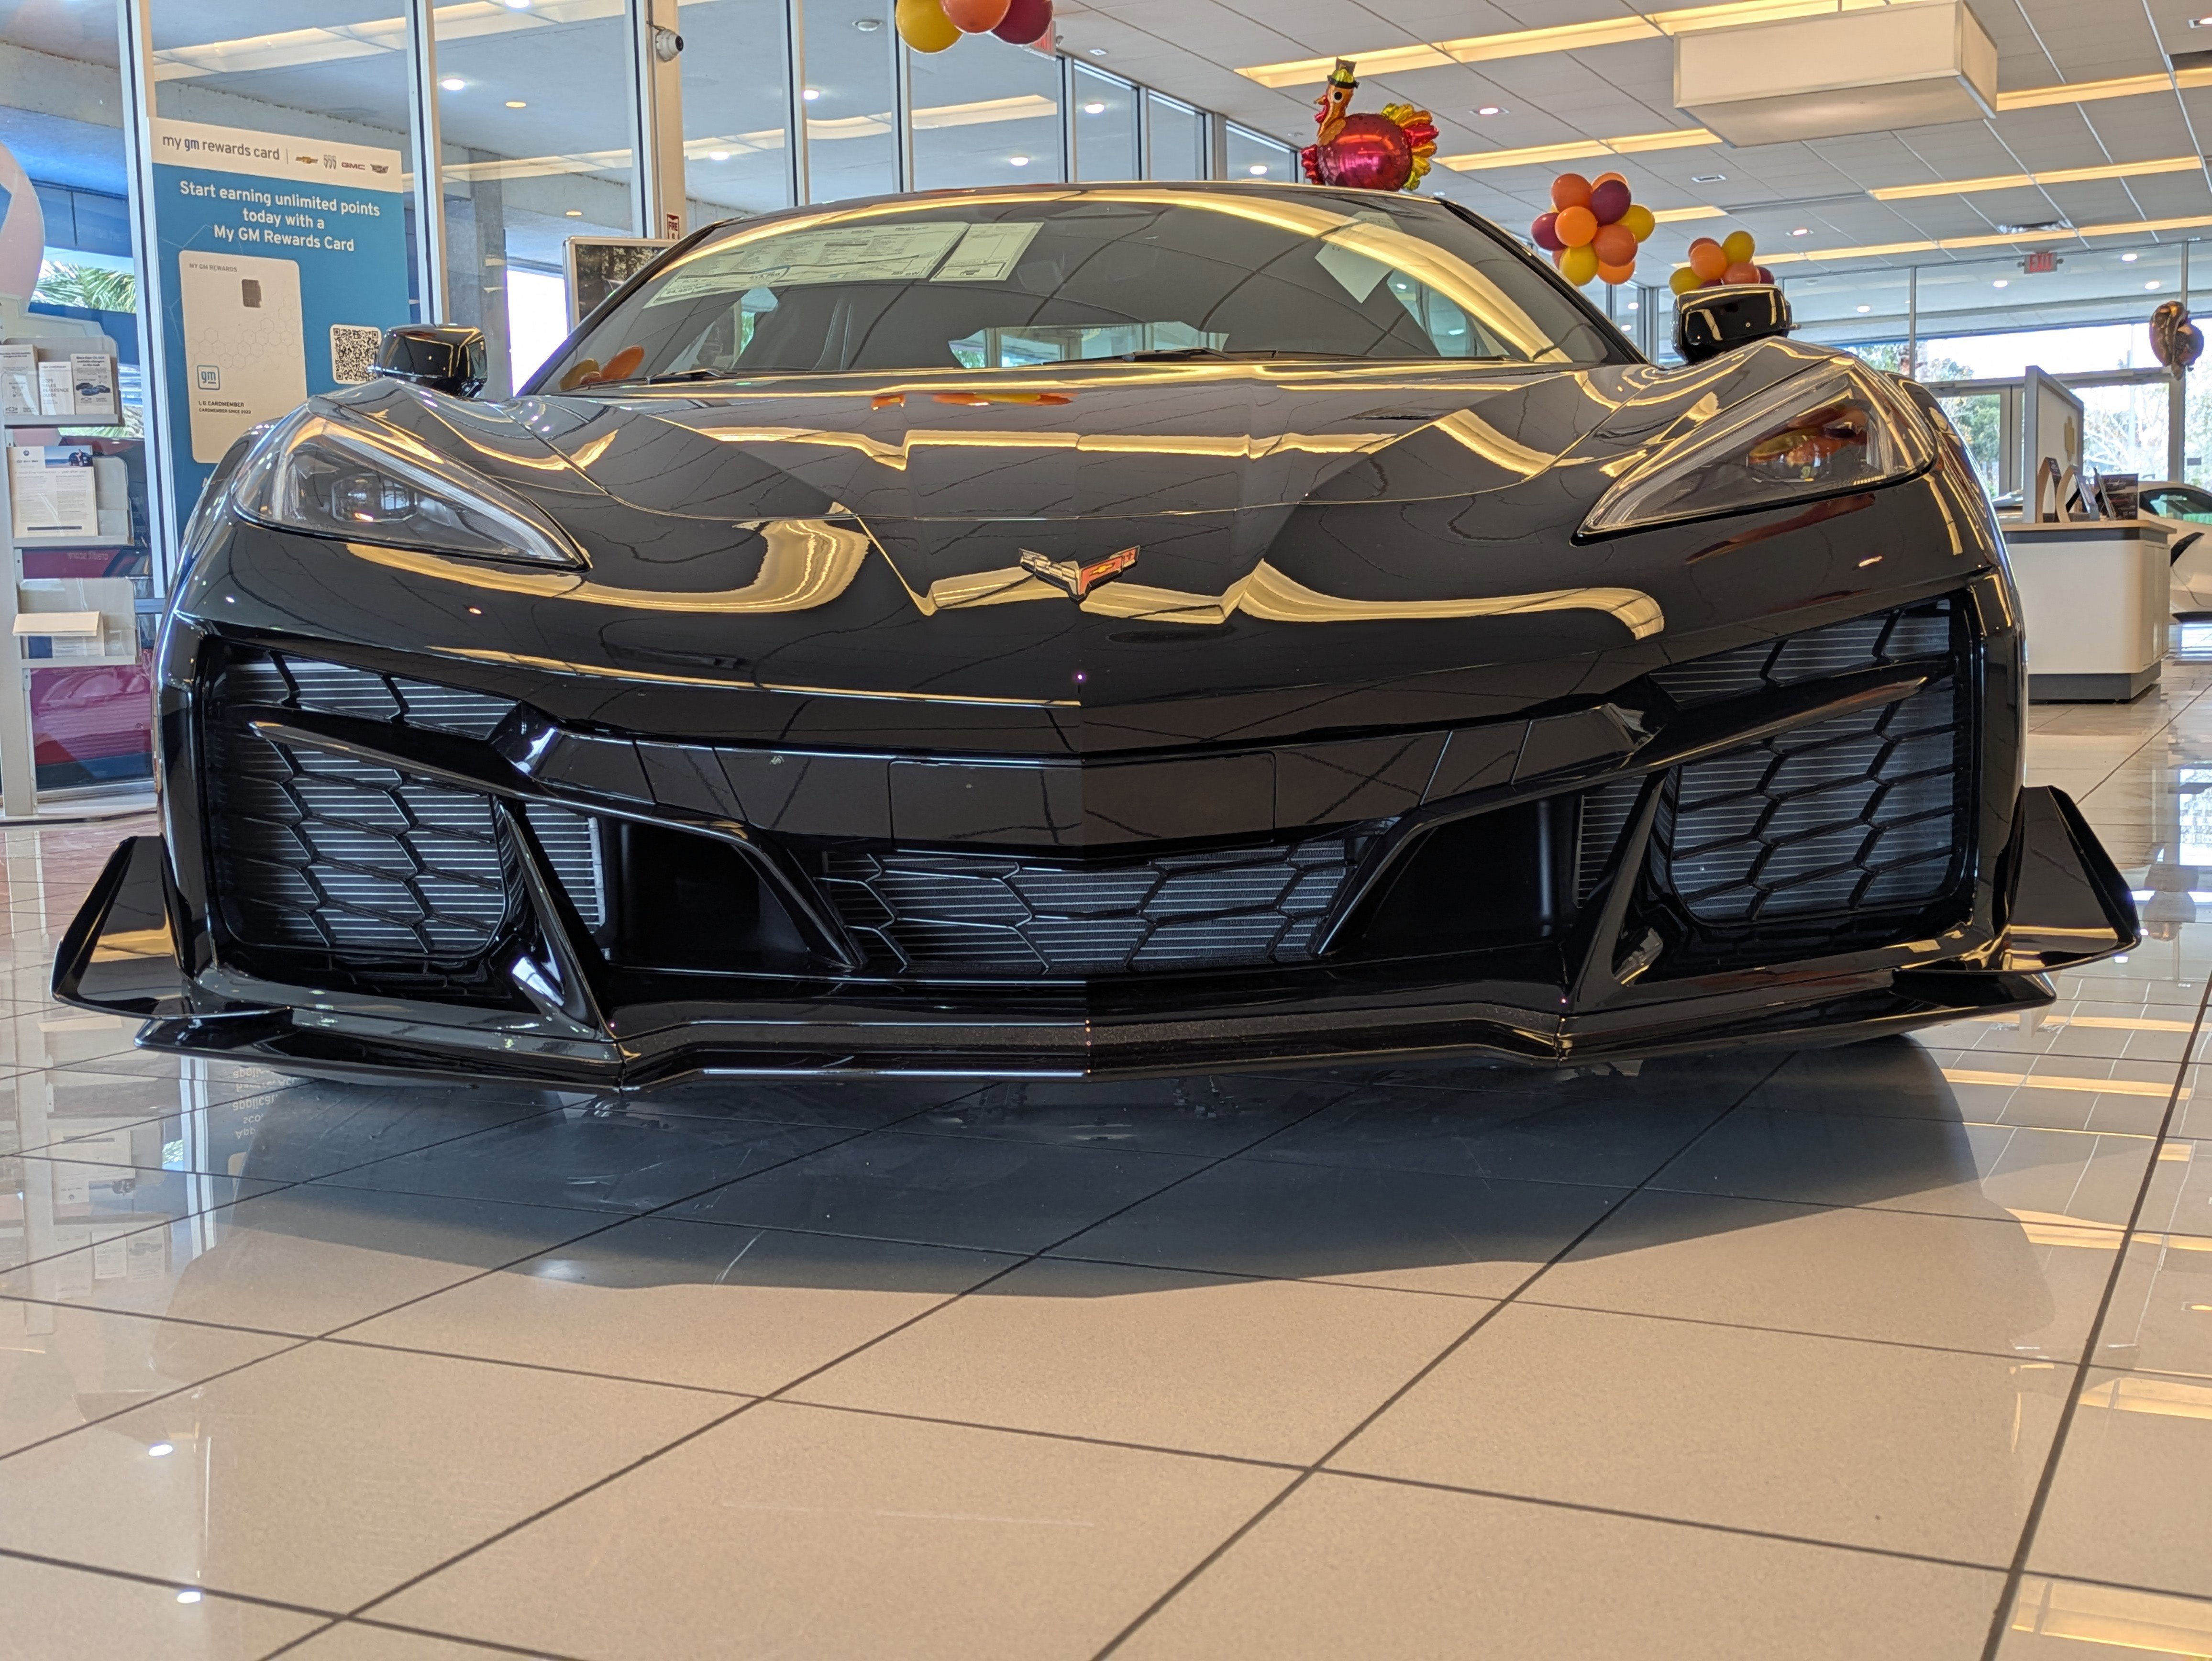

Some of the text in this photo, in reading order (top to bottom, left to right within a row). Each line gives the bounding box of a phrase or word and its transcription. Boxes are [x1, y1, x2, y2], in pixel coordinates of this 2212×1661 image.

[163, 136, 280, 160] my gm rewards card
[341, 162, 365, 170] GMC
[180, 180, 380, 216] Start earning unlimited points
[243, 207, 325, 229] today with a
[668, 221, 678, 232] FIRE
[214, 224, 354, 251] My GM Rewards Card
[2029, 253, 2053, 272] EXIT
[201, 371, 216, 384] gm
